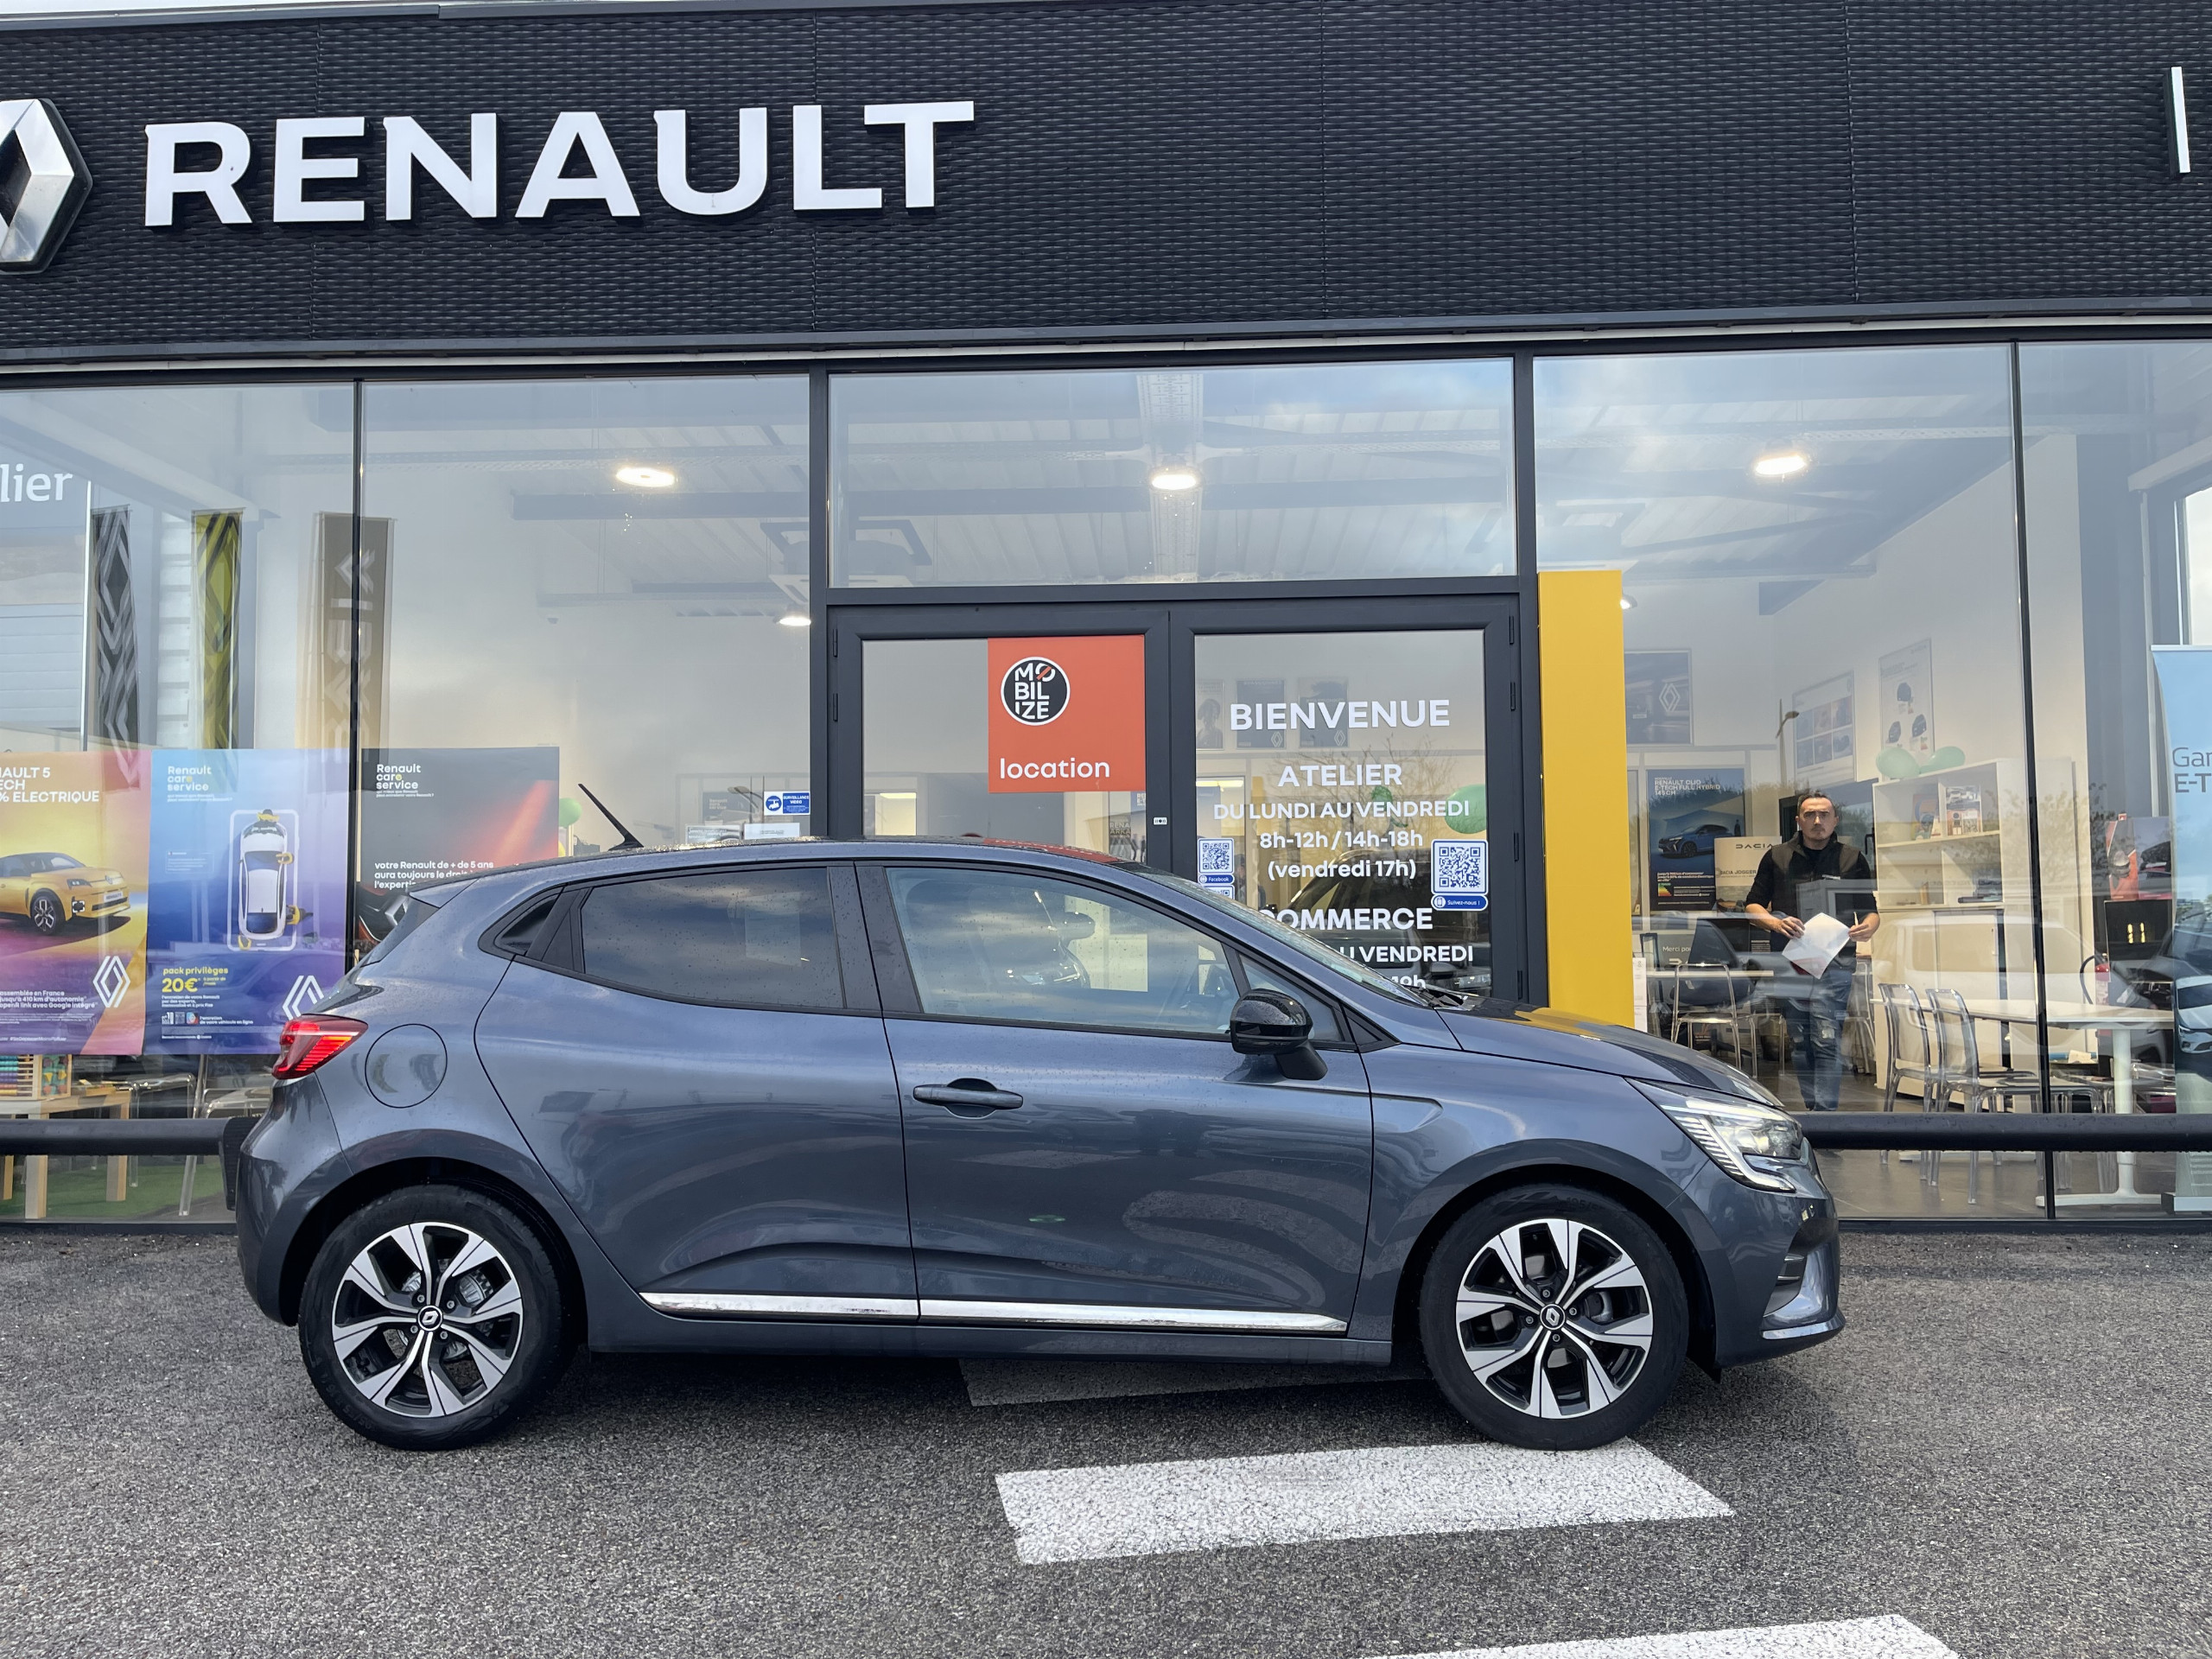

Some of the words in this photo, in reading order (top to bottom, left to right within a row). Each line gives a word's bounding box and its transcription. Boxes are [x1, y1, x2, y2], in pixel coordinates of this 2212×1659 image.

[144, 101, 975, 226] RENAULT
[0, 463, 73, 502] lier
[1230, 700, 1450, 730] BIENVENUE
[0, 767, 40, 779] AULT
[42, 767, 51, 779] 5
[168, 766, 212, 775] Renault
[377, 764, 421, 773] Renault
[1000, 758, 1110, 779] location
[1277, 764, 1402, 786] ATELIER
[168, 783, 209, 791] service
[376, 781, 418, 790] service
[13, 791, 100, 804] ELECTRIQUE
[1214, 804, 1244, 820] DU
[1249, 803, 1315, 819] LUNDI
[1319, 802, 1351, 818] AU
[1356, 800, 1470, 817] VENDREDI
[1260, 831, 1328, 849] 8h-12h
[1344, 830, 1423, 848] 14h-18h
[400, 861, 435, 869] Renault
[1268, 861, 1371, 880] (vendredi
[1376, 859, 1416, 880] 17h)
[397, 871, 435, 880] toujours
[1359, 945, 1473, 963] VENDREDI
[162, 967, 184, 976] pack
[185, 967, 228, 976] privilèges
